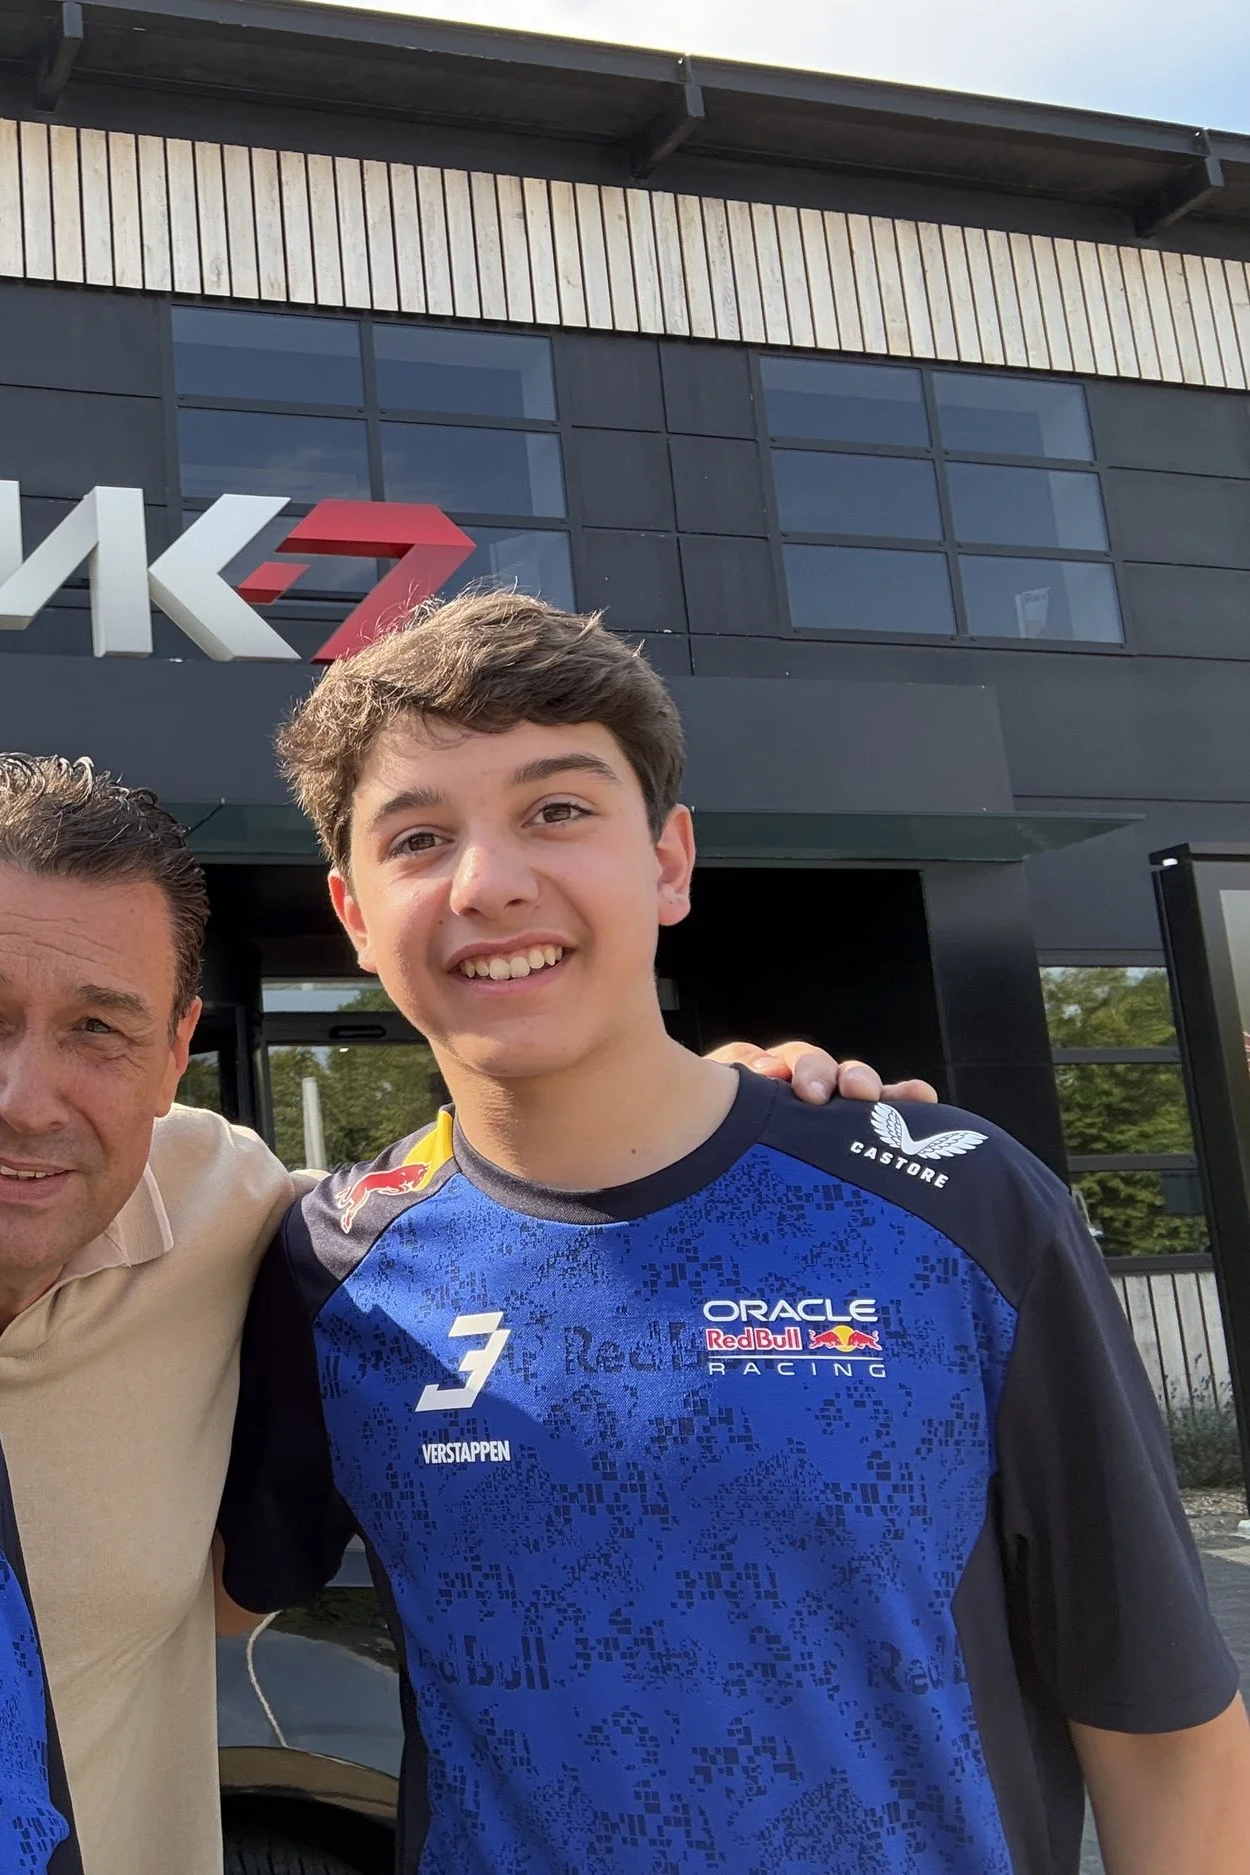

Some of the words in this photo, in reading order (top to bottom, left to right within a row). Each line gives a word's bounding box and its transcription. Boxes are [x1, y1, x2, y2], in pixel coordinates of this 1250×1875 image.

[850, 1141, 950, 1189] CASTORE
[703, 1299, 879, 1322] ORACLE
[414, 1311, 511, 1413] 3
[709, 1362, 887, 1378] RACING
[422, 1440, 511, 1464] VERSTAPPEN
